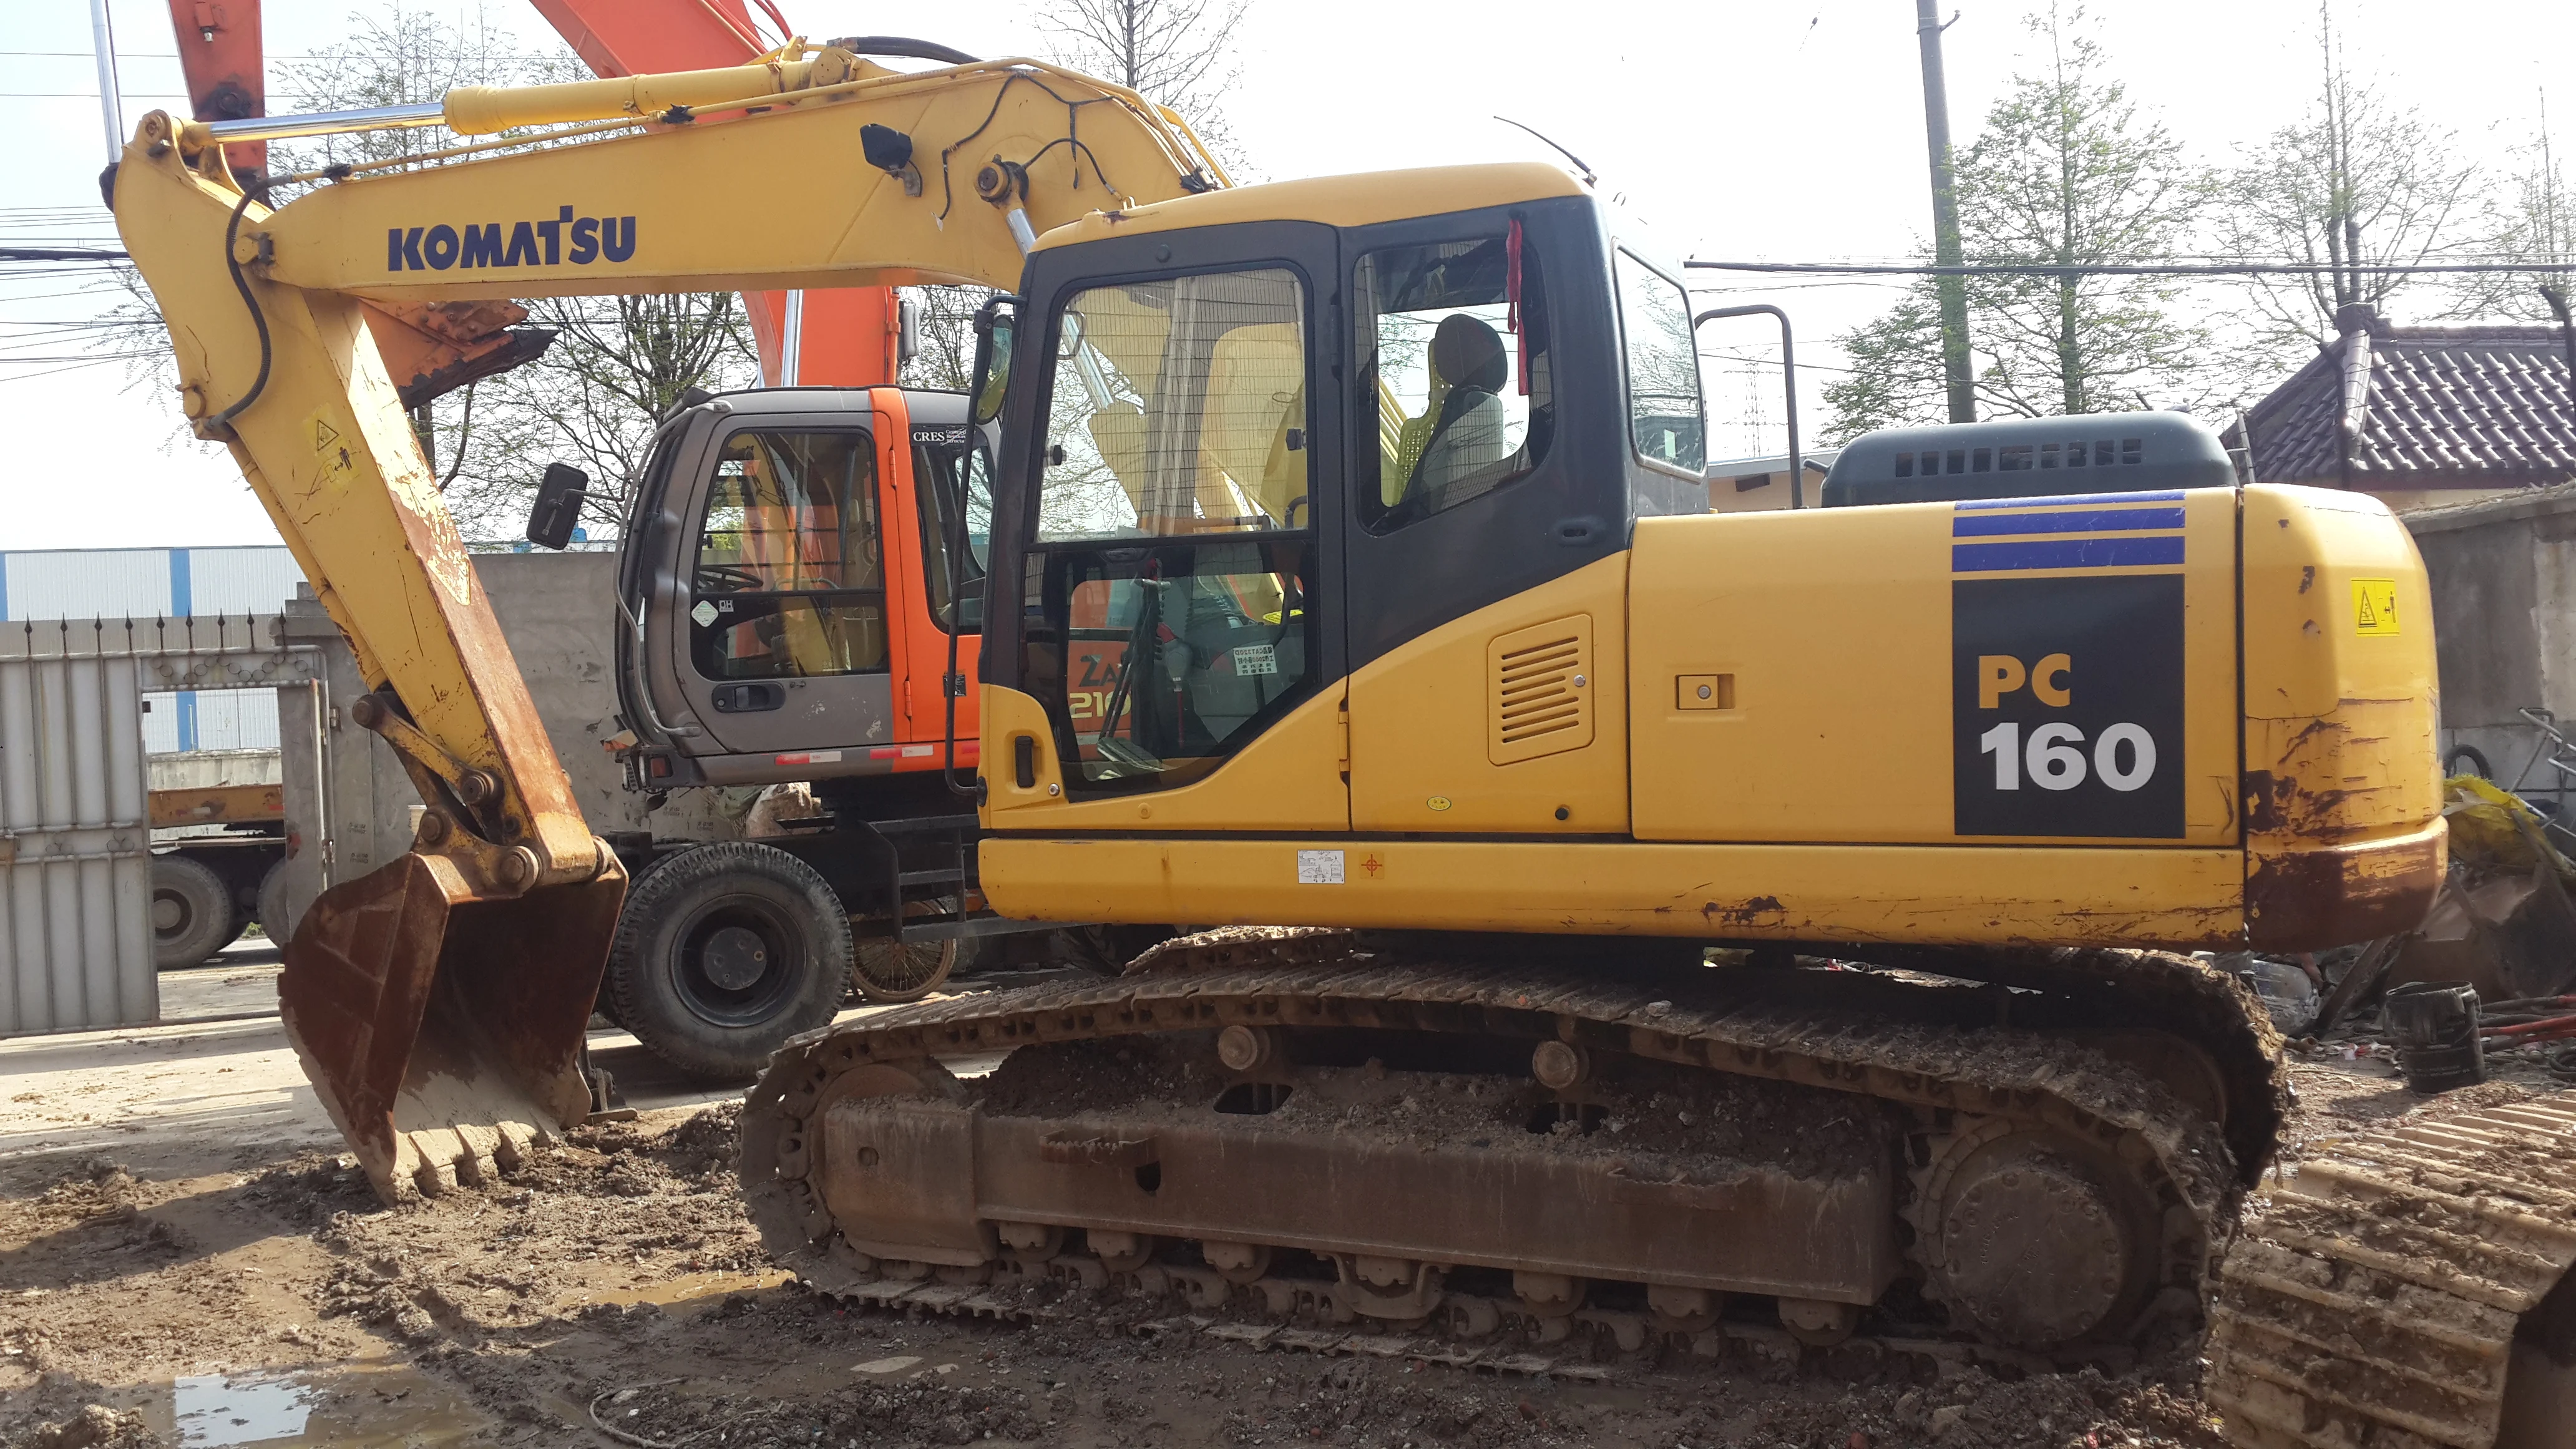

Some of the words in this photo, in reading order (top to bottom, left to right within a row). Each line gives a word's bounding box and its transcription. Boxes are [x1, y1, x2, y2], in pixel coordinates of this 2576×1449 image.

[388, 205, 636, 271] KOMATSU
[913, 432, 945, 441] CRES
[1979, 653, 2071, 709] PC
[1981, 722, 2157, 792] 160
